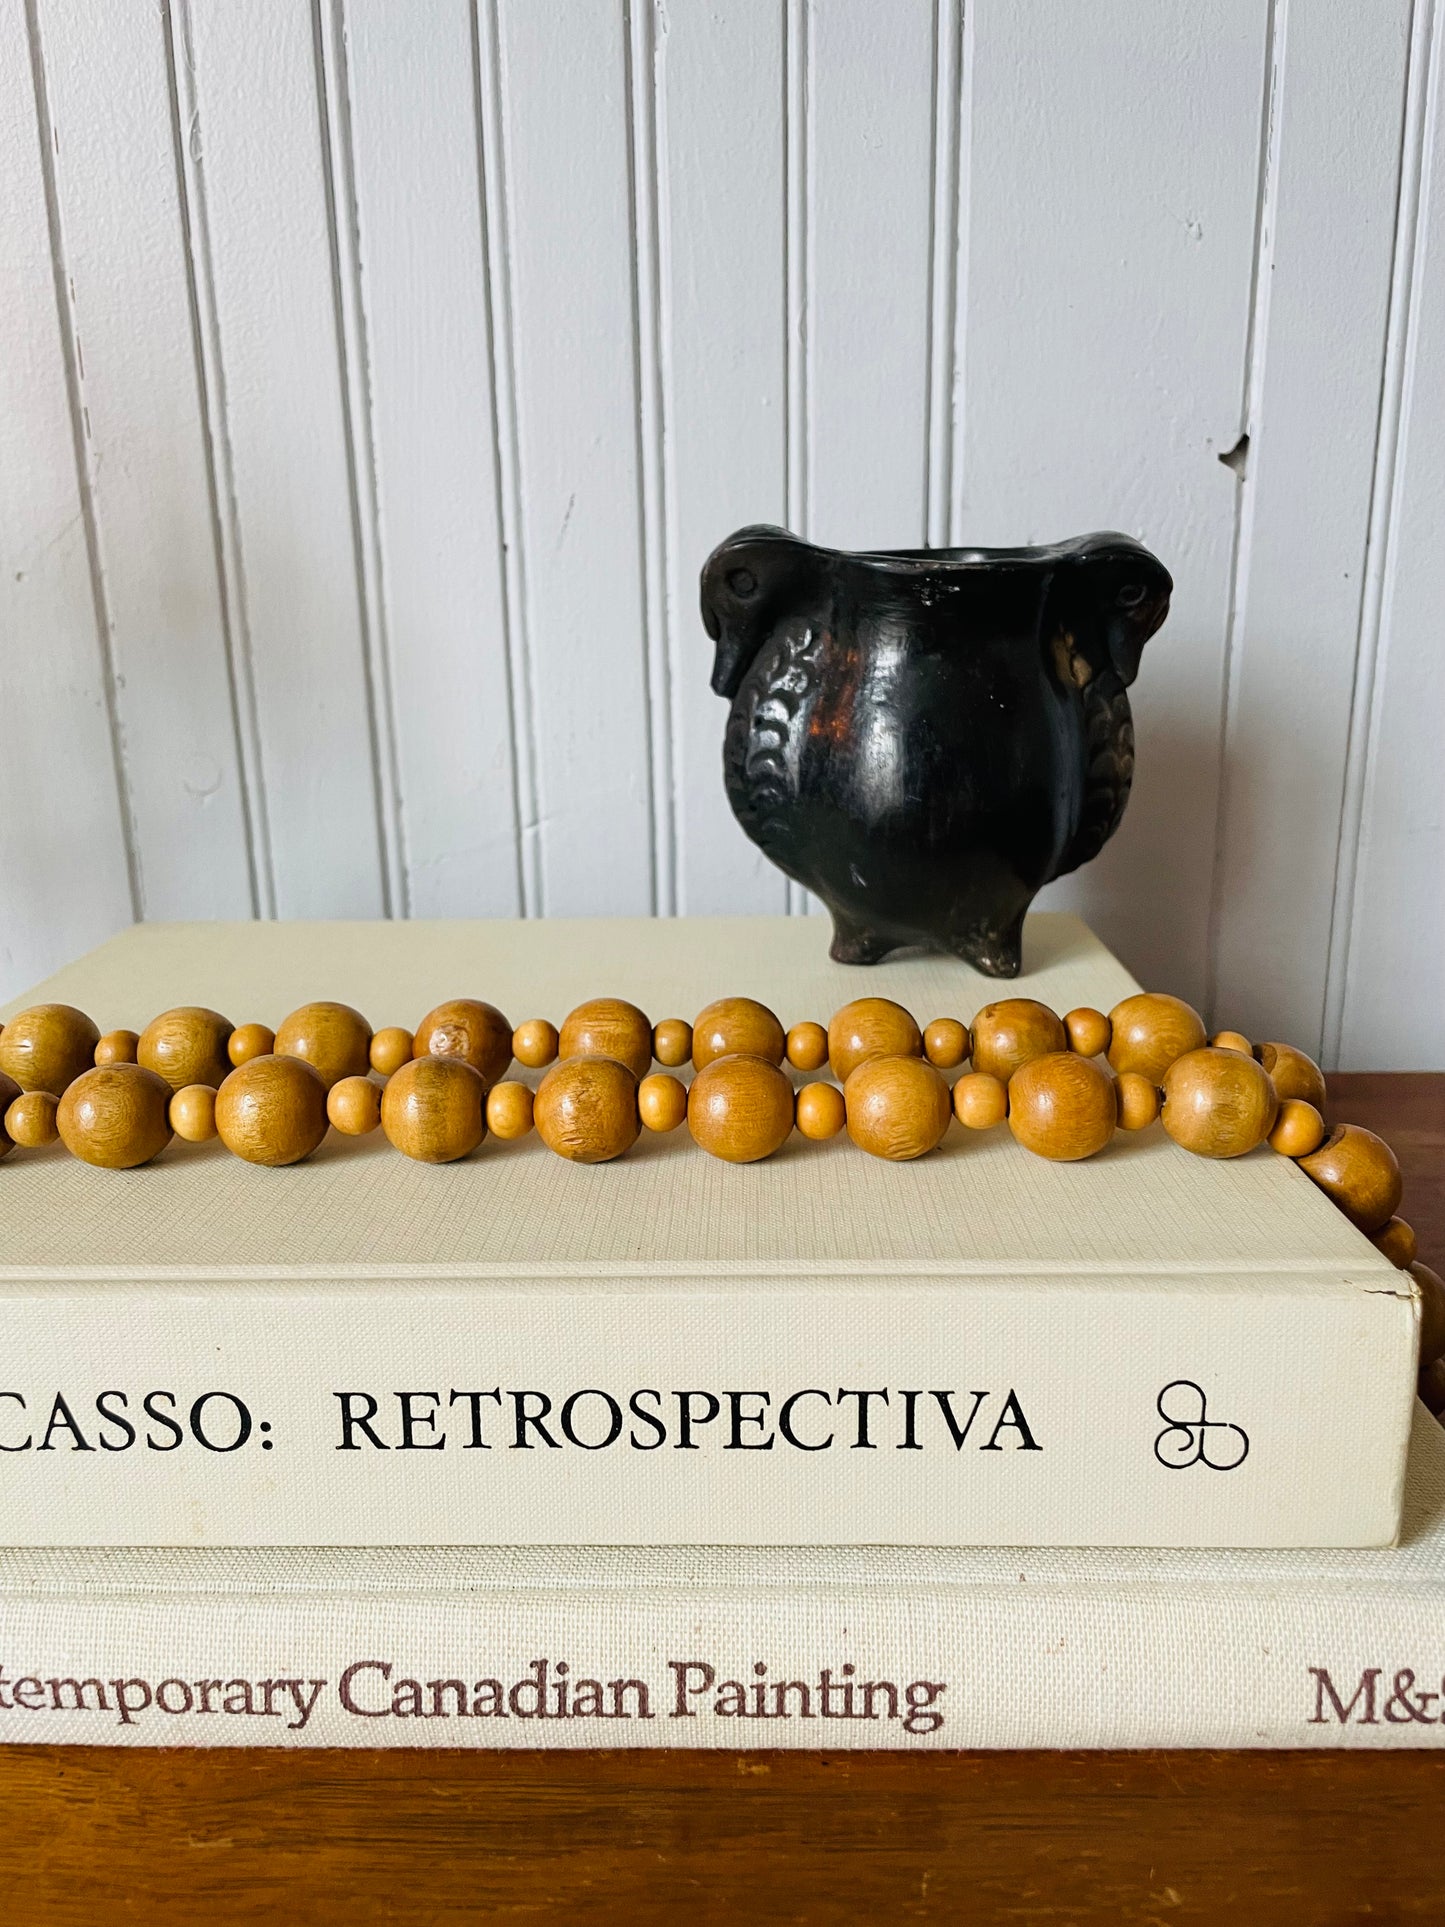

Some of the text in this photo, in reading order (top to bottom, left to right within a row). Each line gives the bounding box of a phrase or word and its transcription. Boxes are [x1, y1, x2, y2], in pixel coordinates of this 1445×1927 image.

[332, 1386, 1044, 1452] RETROSPECTIVA
[339, 1659, 656, 1719] Canadian
[667, 1660, 948, 1736] Painting
[1306, 1666, 1445, 1726] M&
